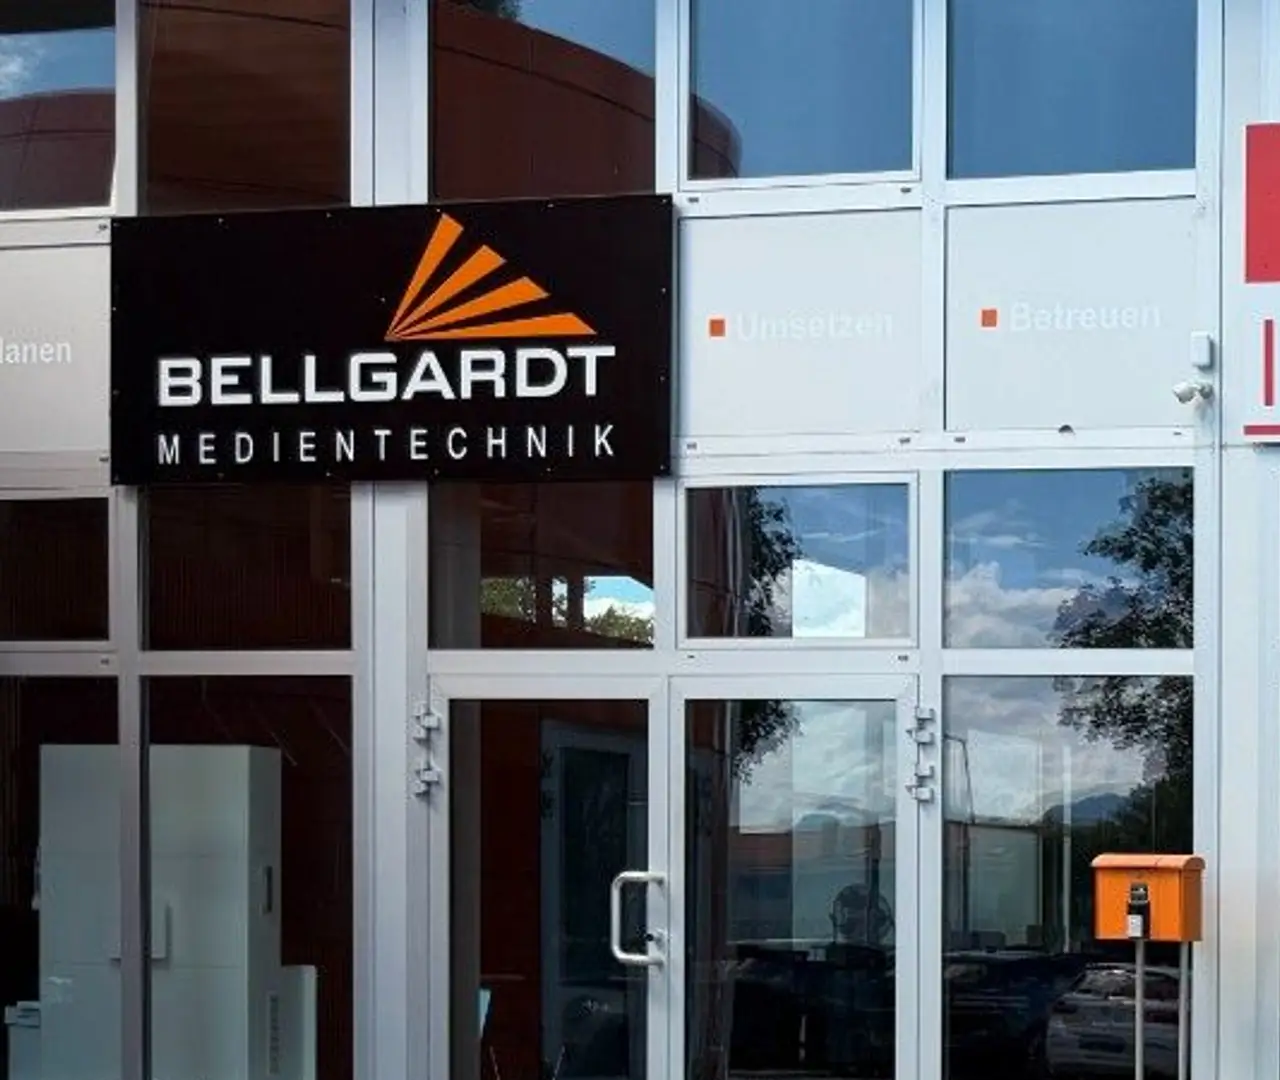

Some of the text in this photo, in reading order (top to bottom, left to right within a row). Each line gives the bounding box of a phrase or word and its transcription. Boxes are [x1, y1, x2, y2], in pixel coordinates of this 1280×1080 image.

[1008, 301, 1162, 333] Betreuen
[0, 336, 71, 364] lanen
[158, 345, 616, 406] BELLGARDT
[158, 424, 615, 464] MEDIENTECHNIK
